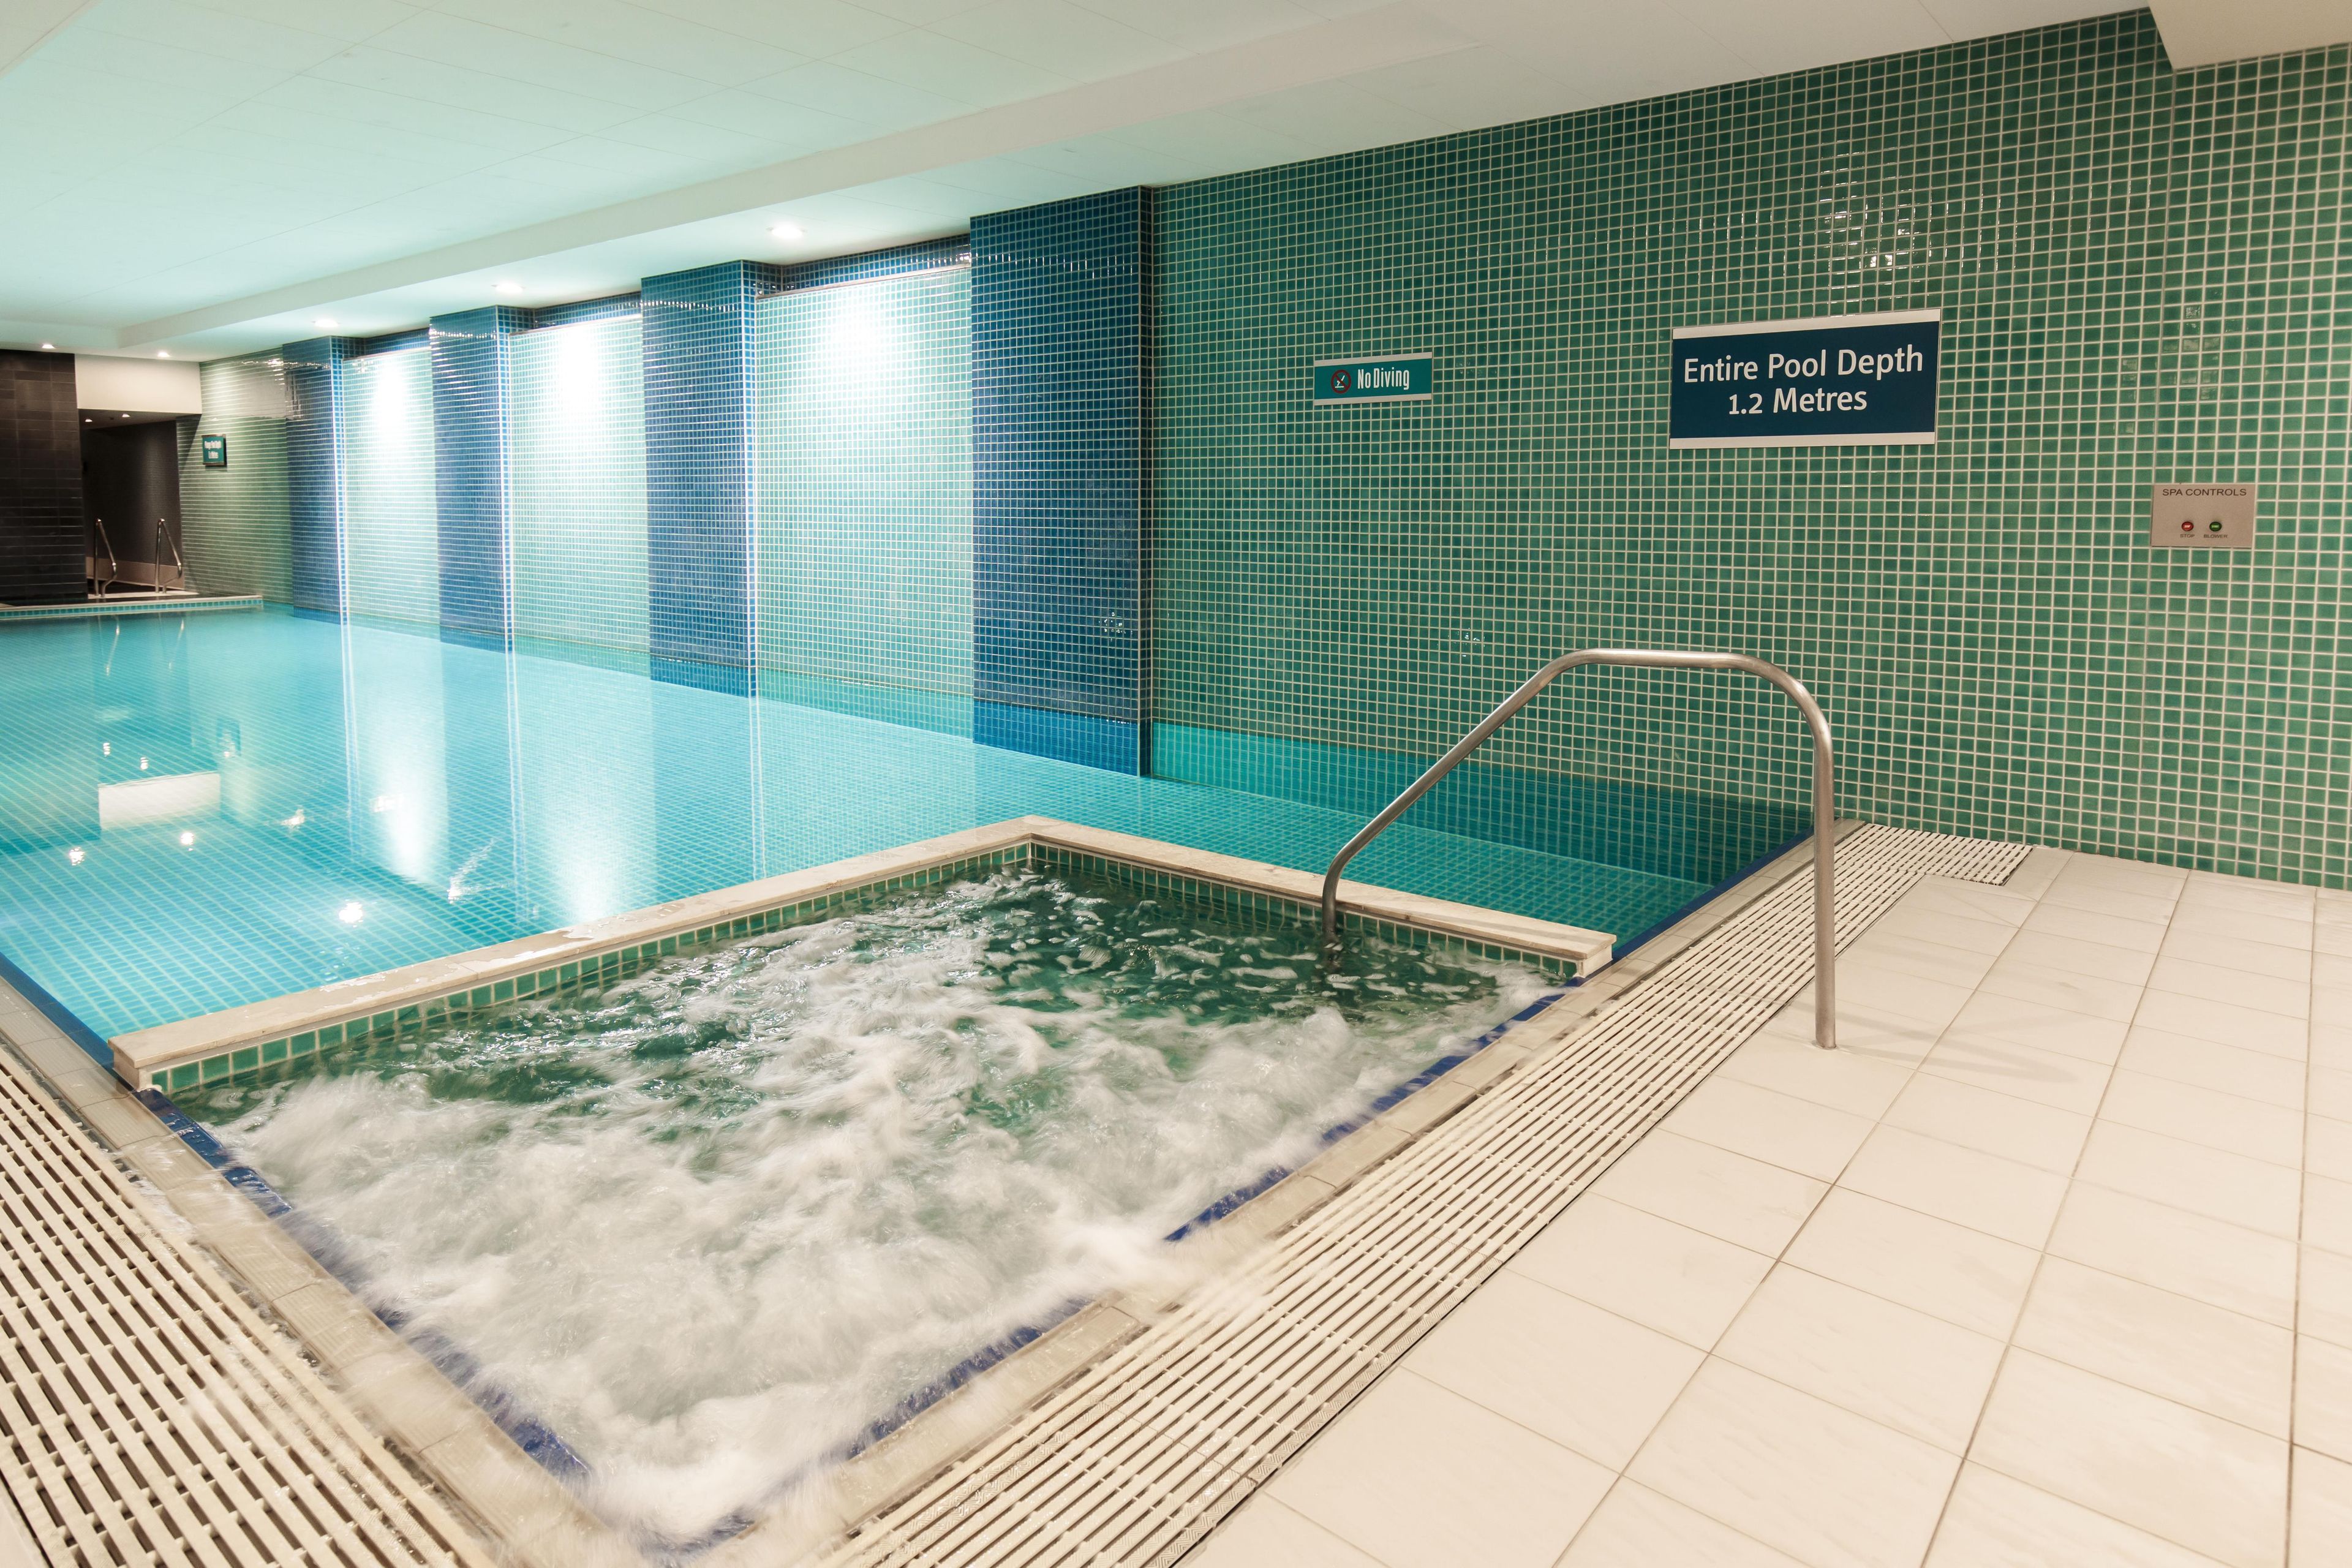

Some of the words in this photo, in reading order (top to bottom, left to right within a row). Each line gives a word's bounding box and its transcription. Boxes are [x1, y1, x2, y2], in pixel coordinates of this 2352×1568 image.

[1684, 355, 1758, 383] Entire
[1768, 349, 1826, 379] Pool
[1838, 344, 1923, 380] Depth
[1357, 369, 1371, 389] No
[1373, 367, 1409, 390] Diving
[1728, 393, 1763, 415] 1.2
[1773, 387, 1868, 413] Metres
